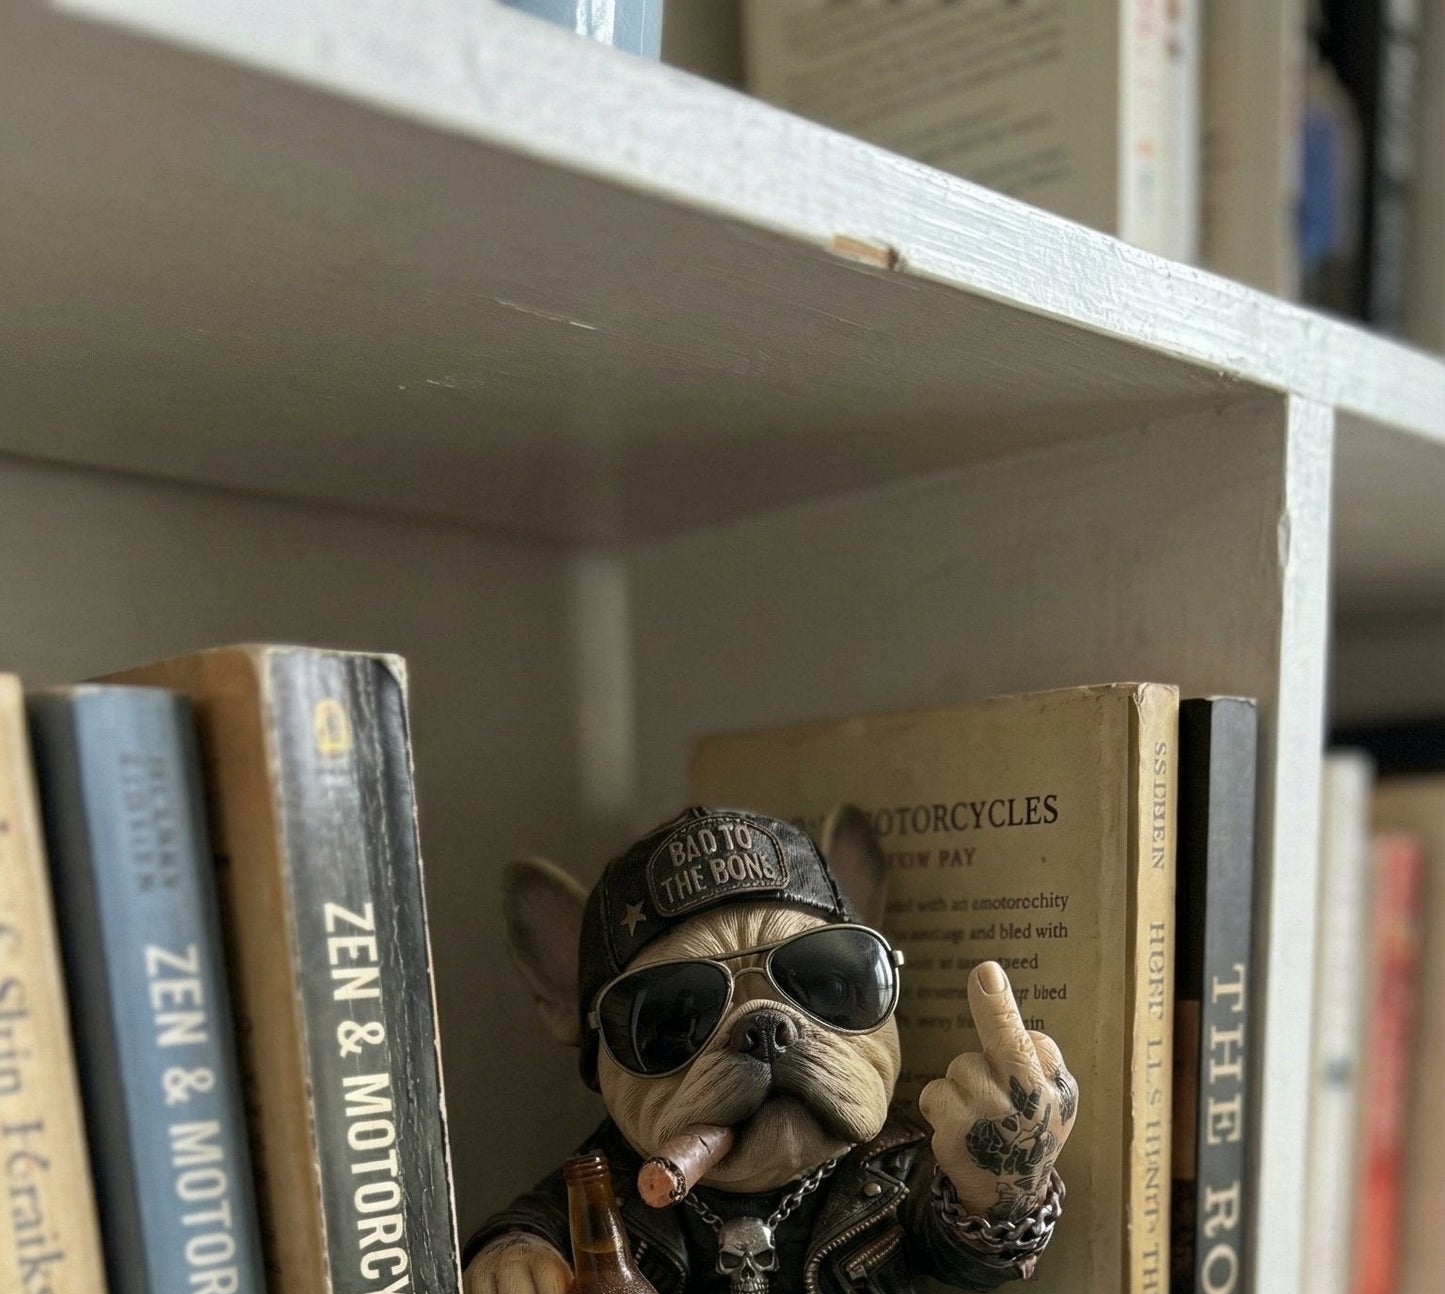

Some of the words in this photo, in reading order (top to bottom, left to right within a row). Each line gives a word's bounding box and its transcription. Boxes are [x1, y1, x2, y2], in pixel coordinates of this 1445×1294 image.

[874, 794, 1058, 838] OTORCYCLES
[668, 829, 717, 868] BAD
[718, 823, 753, 851] TO
[939, 847, 976, 868] PAY
[660, 865, 708, 903] THE
[1036, 922, 1068, 939] with
[323, 902, 381, 1001] ZEN
[145, 943, 208, 1048] ZEN
[336, 1020, 385, 1058] &
[1207, 963, 1247, 1146] THE
[162, 1067, 215, 1106] &
